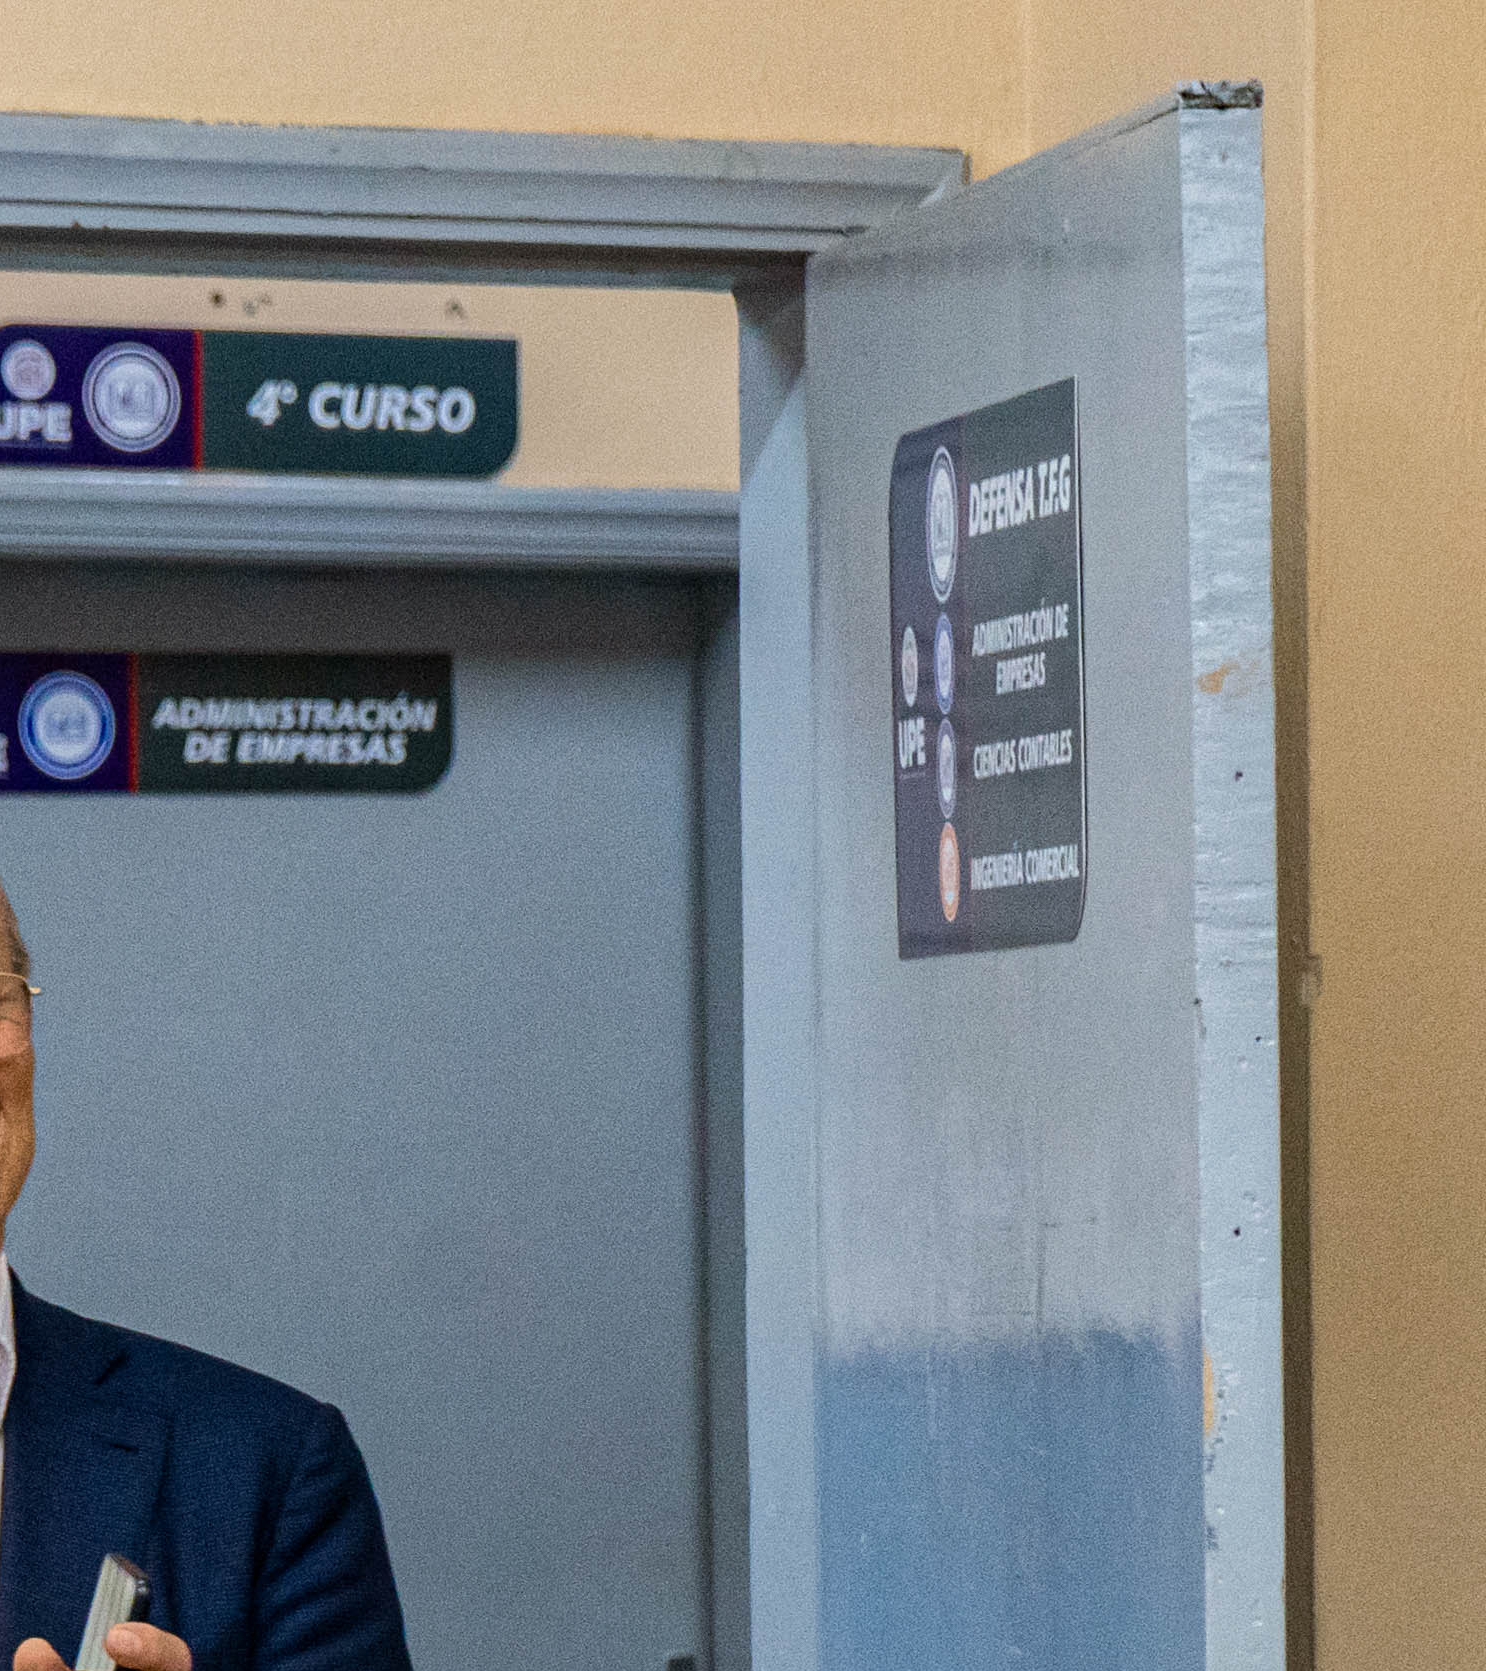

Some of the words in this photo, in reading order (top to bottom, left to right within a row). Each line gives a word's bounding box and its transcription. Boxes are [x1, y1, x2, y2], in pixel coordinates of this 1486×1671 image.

[308, 381, 476, 434] CURSO
[969, 465, 1035, 537] DEFENSA
[971, 598, 1053, 657] ADMINISTRACIÓN
[1055, 603, 1069, 638] DE
[996, 652, 1046, 695] EMPRESAS
[152, 690, 439, 732] ADMINISTRACIÓN
[184, 733, 229, 764] DE
[235, 733, 409, 766] EMPRESAS
[898, 717, 926, 769] UPE
[974, 738, 1017, 780] CIENCIAS
[1018, 729, 1072, 771] CONTABLES
[970, 840, 1024, 890] INGENIERÍA
[1025, 844, 1079, 884] COMERCIAL
